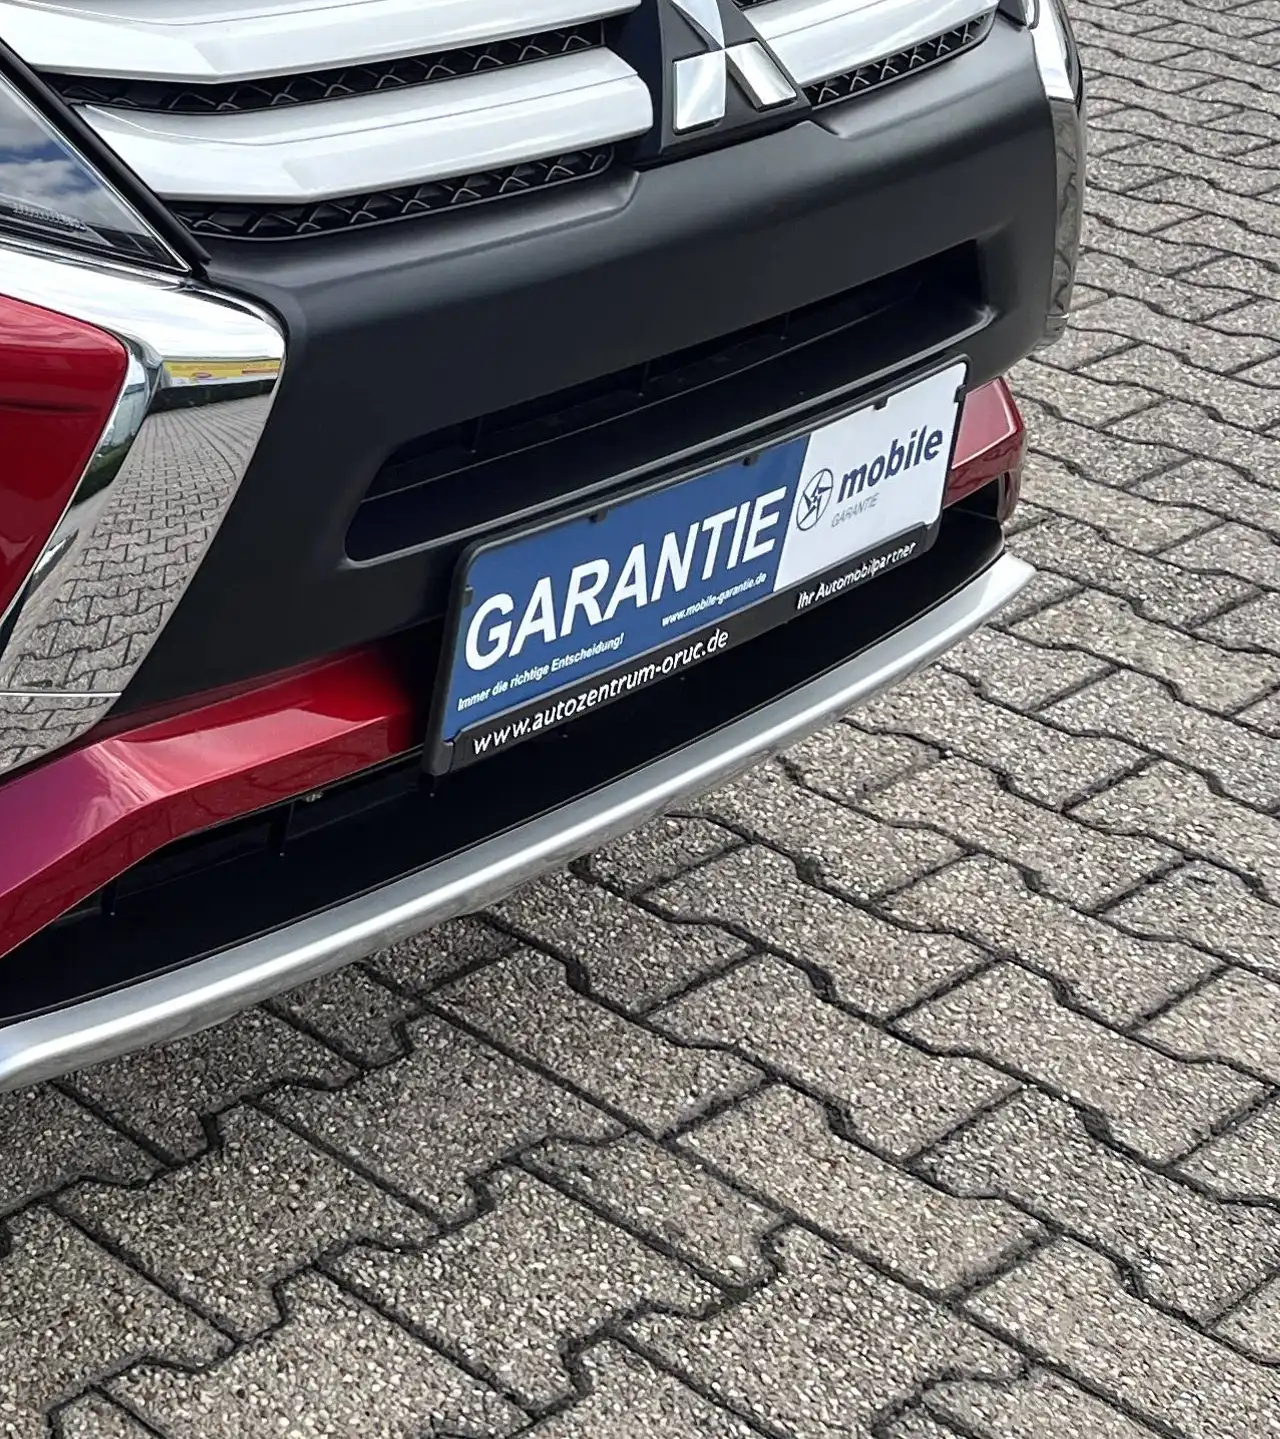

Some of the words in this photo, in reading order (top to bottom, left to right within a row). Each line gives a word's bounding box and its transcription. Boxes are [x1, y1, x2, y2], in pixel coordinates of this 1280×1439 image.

[837, 425, 943, 504] mobile
[465, 485, 788, 672] GARANTIE
[797, 586, 816, 610] Ihr
[815, 541, 917, 601] Automobilpartner
[457, 688, 492, 712] Immer
[492, 673, 509, 694] die
[509, 661, 549, 689] richtige
[550, 632, 626, 672] Entscheidung!
[473, 628, 729, 755] www.autozentrum-oruc.de
